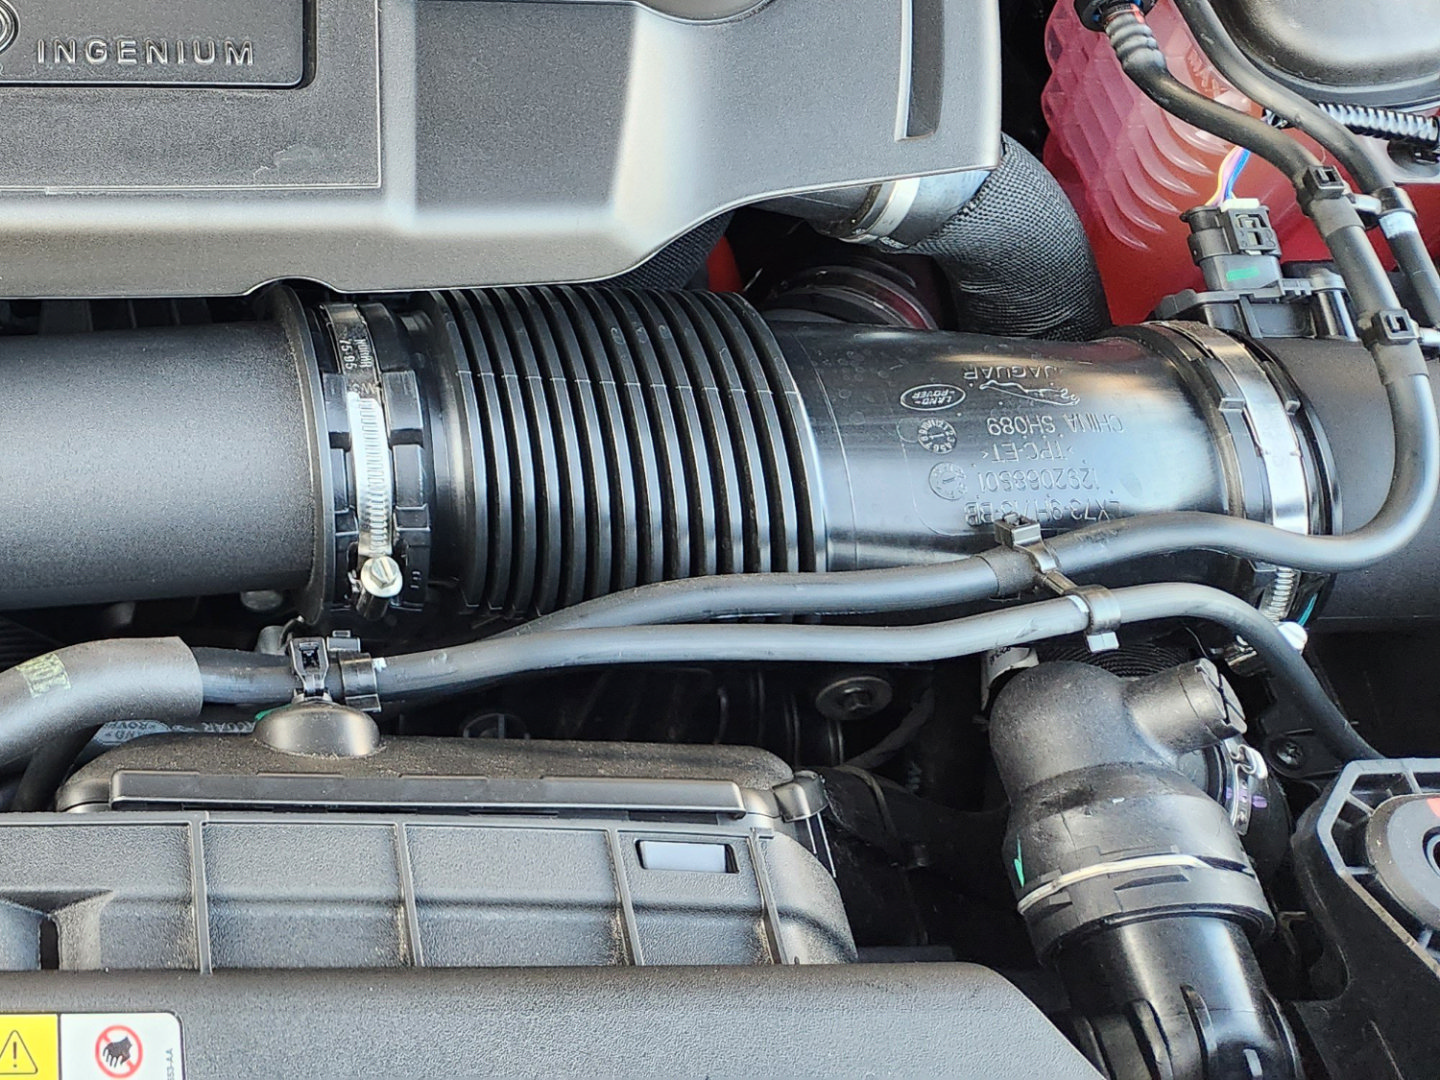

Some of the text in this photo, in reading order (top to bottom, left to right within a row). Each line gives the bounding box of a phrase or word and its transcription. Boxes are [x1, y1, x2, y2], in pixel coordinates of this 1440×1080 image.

[36, 38, 255, 66] INGENIUM
[964, 365, 1054, 380] JAGUAR
[986, 413, 1125, 436] CHINA SH089
